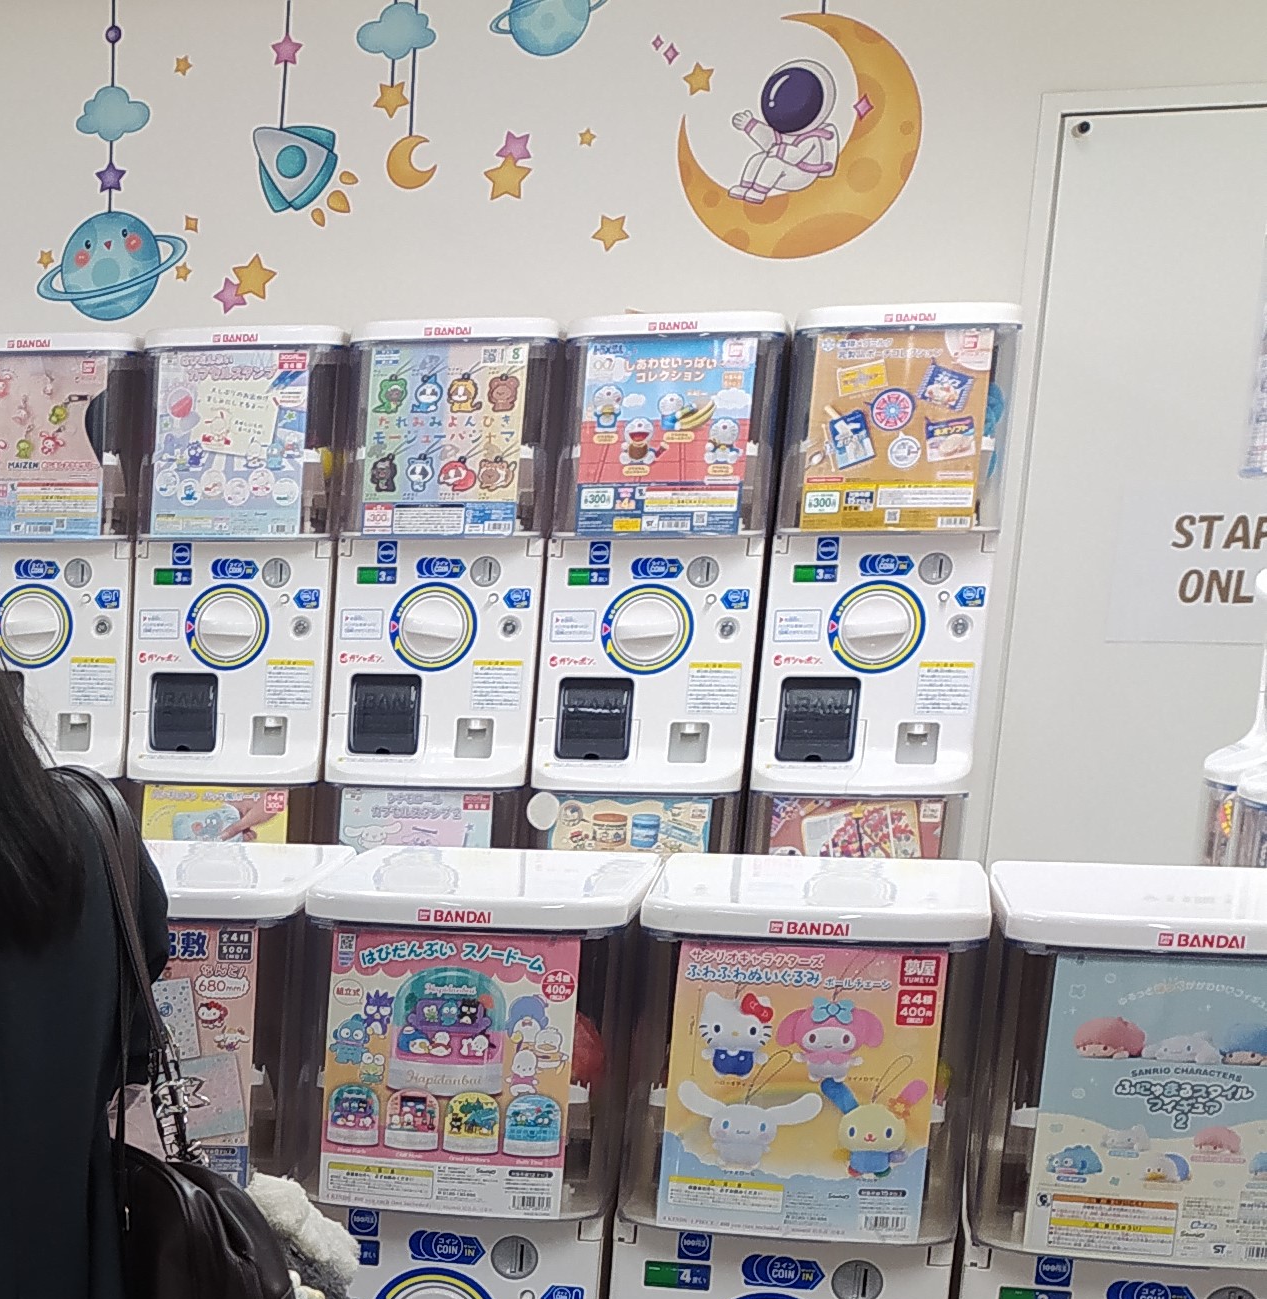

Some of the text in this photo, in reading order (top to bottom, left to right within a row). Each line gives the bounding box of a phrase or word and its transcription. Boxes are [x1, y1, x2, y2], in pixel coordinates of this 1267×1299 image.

[896, 313, 936, 322] BANDAI
[434, 327, 472, 336] BANDAI
[658, 321, 697, 330] BANDAI
[16, 340, 50, 348] BANDAI
[223, 334, 258, 343] BANDAI
[625, 356, 717, 371] しあわせいっぱい
[635, 370, 705, 383] コレクション
[8, 462, 39, 470] MAIZEN
[1178, 569, 1255, 604] ONL
[433, 910, 491, 924] BANDAI
[786, 922, 850, 937] BANDAI
[1177, 934, 1246, 949] BANDAI
[360, 941, 546, 974] はぴだんぶい スノードーム
[689, 949, 825, 969] サンリオキャラクターズ
[904, 958, 937, 976] 夢屋
[686, 963, 822, 986] ふわふわぬいぐるみ
[903, 976, 935, 984] YUMEYA
[198, 980, 246, 993] 680mm!
[336, 987, 361, 997] 組立式
[900, 993, 934, 1006] 全4種
[899, 1006, 934, 1018] 400円
[406, 1068, 482, 1086] Hapidanbui
[1131, 1067, 1243, 1082] SANRIO CHARACTERS
[1115, 1078, 1255, 1101] ふにゅまるスタイル
[1147, 1097, 1223, 1115] フィギュア
[1174, 1113, 1189, 1130] 2
[438, 1237, 458, 1245] コイン
[437, 1244, 458, 1255] COIN
[464, 1248, 475, 1257] IN
[773, 1261, 794, 1269] コイン
[680, 1269, 691, 1284] 4
[772, 1268, 795, 1279] COIN
[802, 1272, 813, 1281] IN
[1141, 1288, 1165, 1296] コイン
